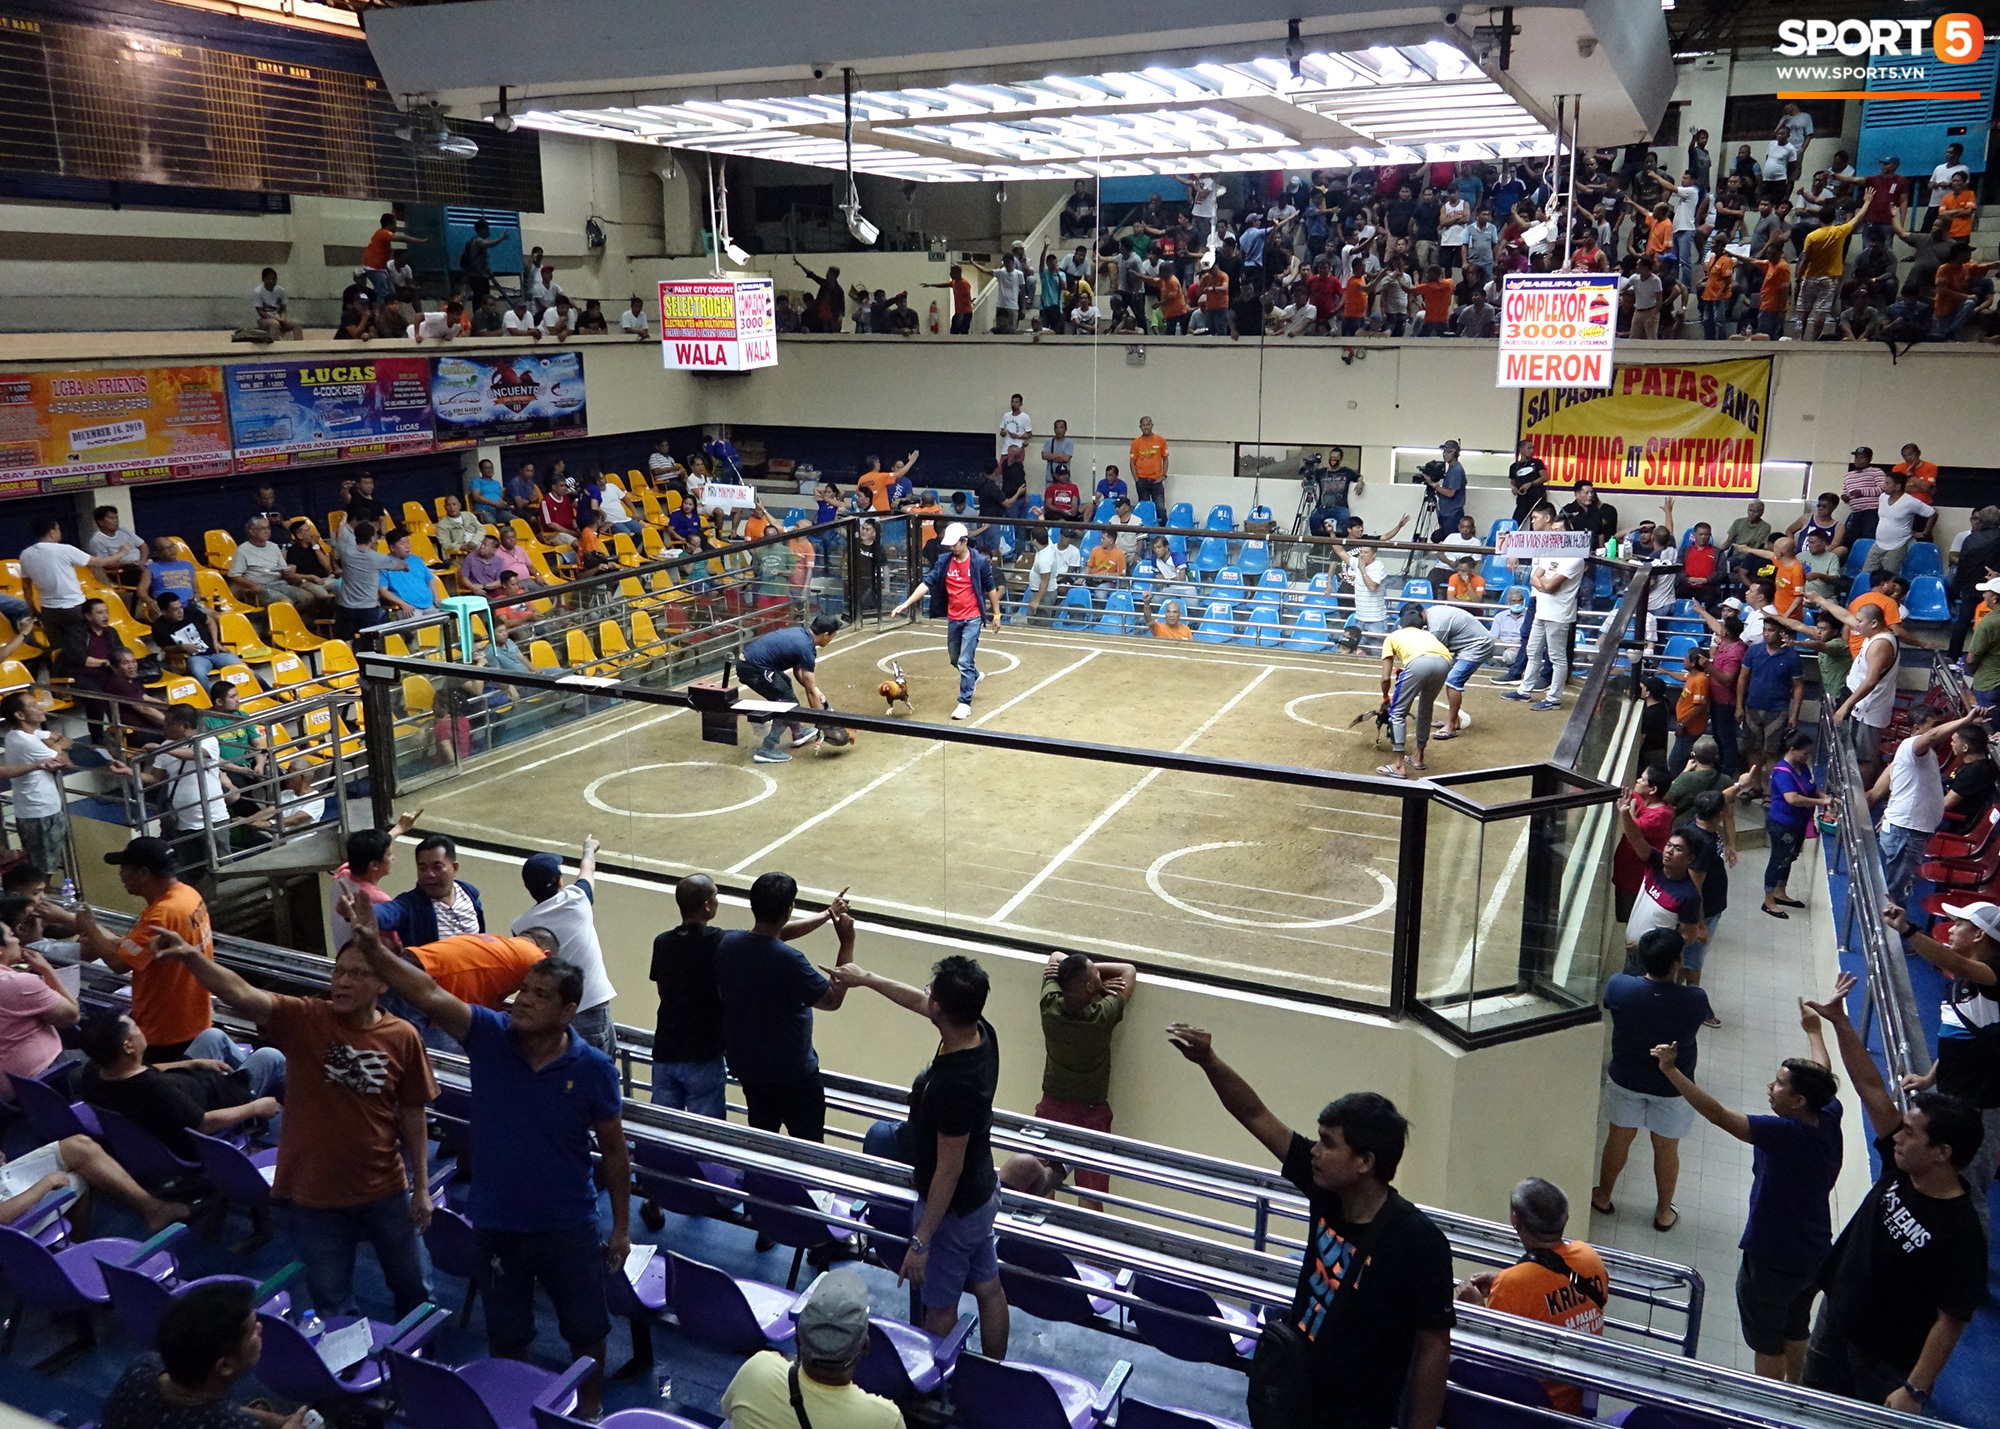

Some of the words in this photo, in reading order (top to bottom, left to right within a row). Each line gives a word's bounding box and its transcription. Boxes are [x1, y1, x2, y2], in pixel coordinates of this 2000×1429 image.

[708, 286, 734, 294] COCKPIT
[664, 295, 734, 318] SELECTROGEN
[1506, 293, 1587, 322] COMPLEXOR
[740, 316, 763, 329] 3000
[1506, 324, 1576, 338] 3000
[676, 343, 727, 365] WALA
[745, 340, 771, 362] WALA
[299, 366, 377, 383] LUCAS
[1506, 354, 1602, 381] MERON
[52, 380, 85, 397] LGBA
[97, 376, 147, 395] FRIENDS
[313, 386, 341, 397] 4-COCK
[342, 384, 366, 396] DERBY
[486, 385, 547, 399] ENCUENTRO
[1527, 390, 1550, 428] SA
[1623, 367, 1719, 408] PATAS
[1721, 383, 1760, 435] ANG
[72, 427, 112, 442] DECEMBER
[126, 421, 143, 433] 2019
[396, 423, 420, 431] LUCAS
[87, 434, 135, 446] MONDAY
[314, 441, 331, 449] ANG
[332, 437, 373, 447] MATCHING
[71, 464, 95, 473] ANG
[97, 459, 151, 470] MATCHING
[154, 456, 166, 465] AT
[1526, 433, 1624, 485] MATCHING
[1625, 445, 1643, 477] AT
[1644, 436, 1754, 488] SENTENCIA
[1498, 536, 1506, 551] 7
[1507, 534, 1525, 548] OYOTA
[1902, 1241, 1915, 1253] 81
[1545, 1275, 1604, 1316] KRISO
[1565, 1317, 1576, 1329] SA
